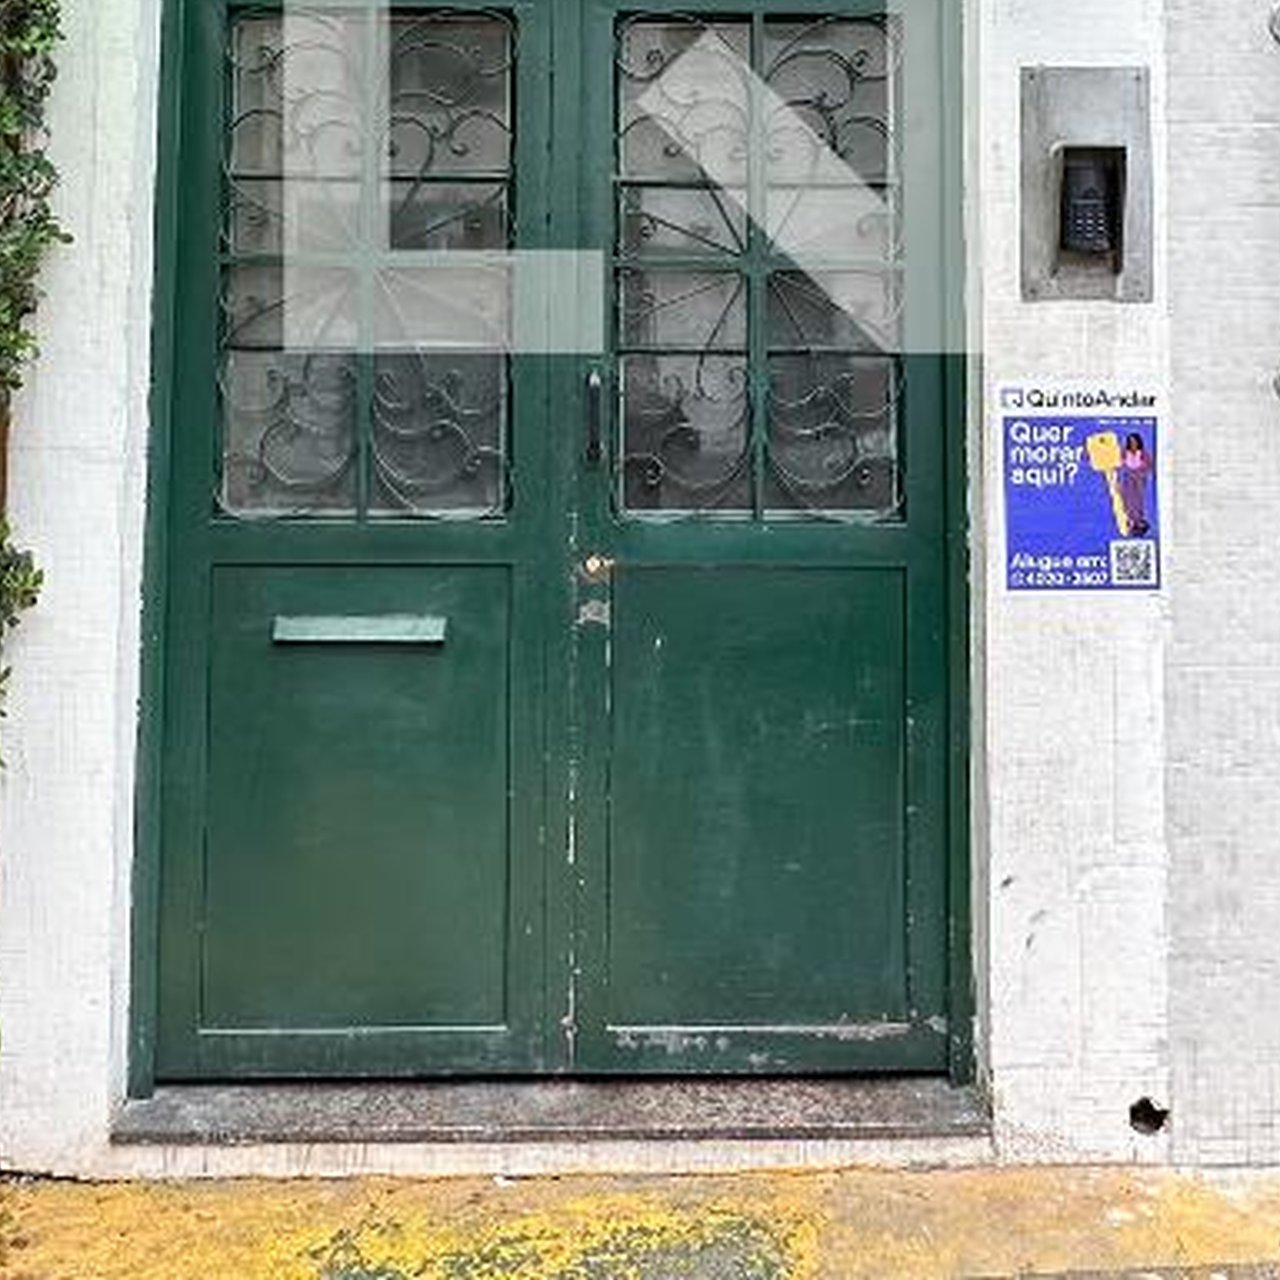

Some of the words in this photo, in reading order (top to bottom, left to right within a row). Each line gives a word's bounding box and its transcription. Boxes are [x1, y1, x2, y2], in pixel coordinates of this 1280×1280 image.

[1025, 388, 1157, 408] QuintoAndar
[1009, 421, 1074, 444] Quer
[1010, 445, 1084, 465] morar
[1011, 463, 1079, 489] aqui?
